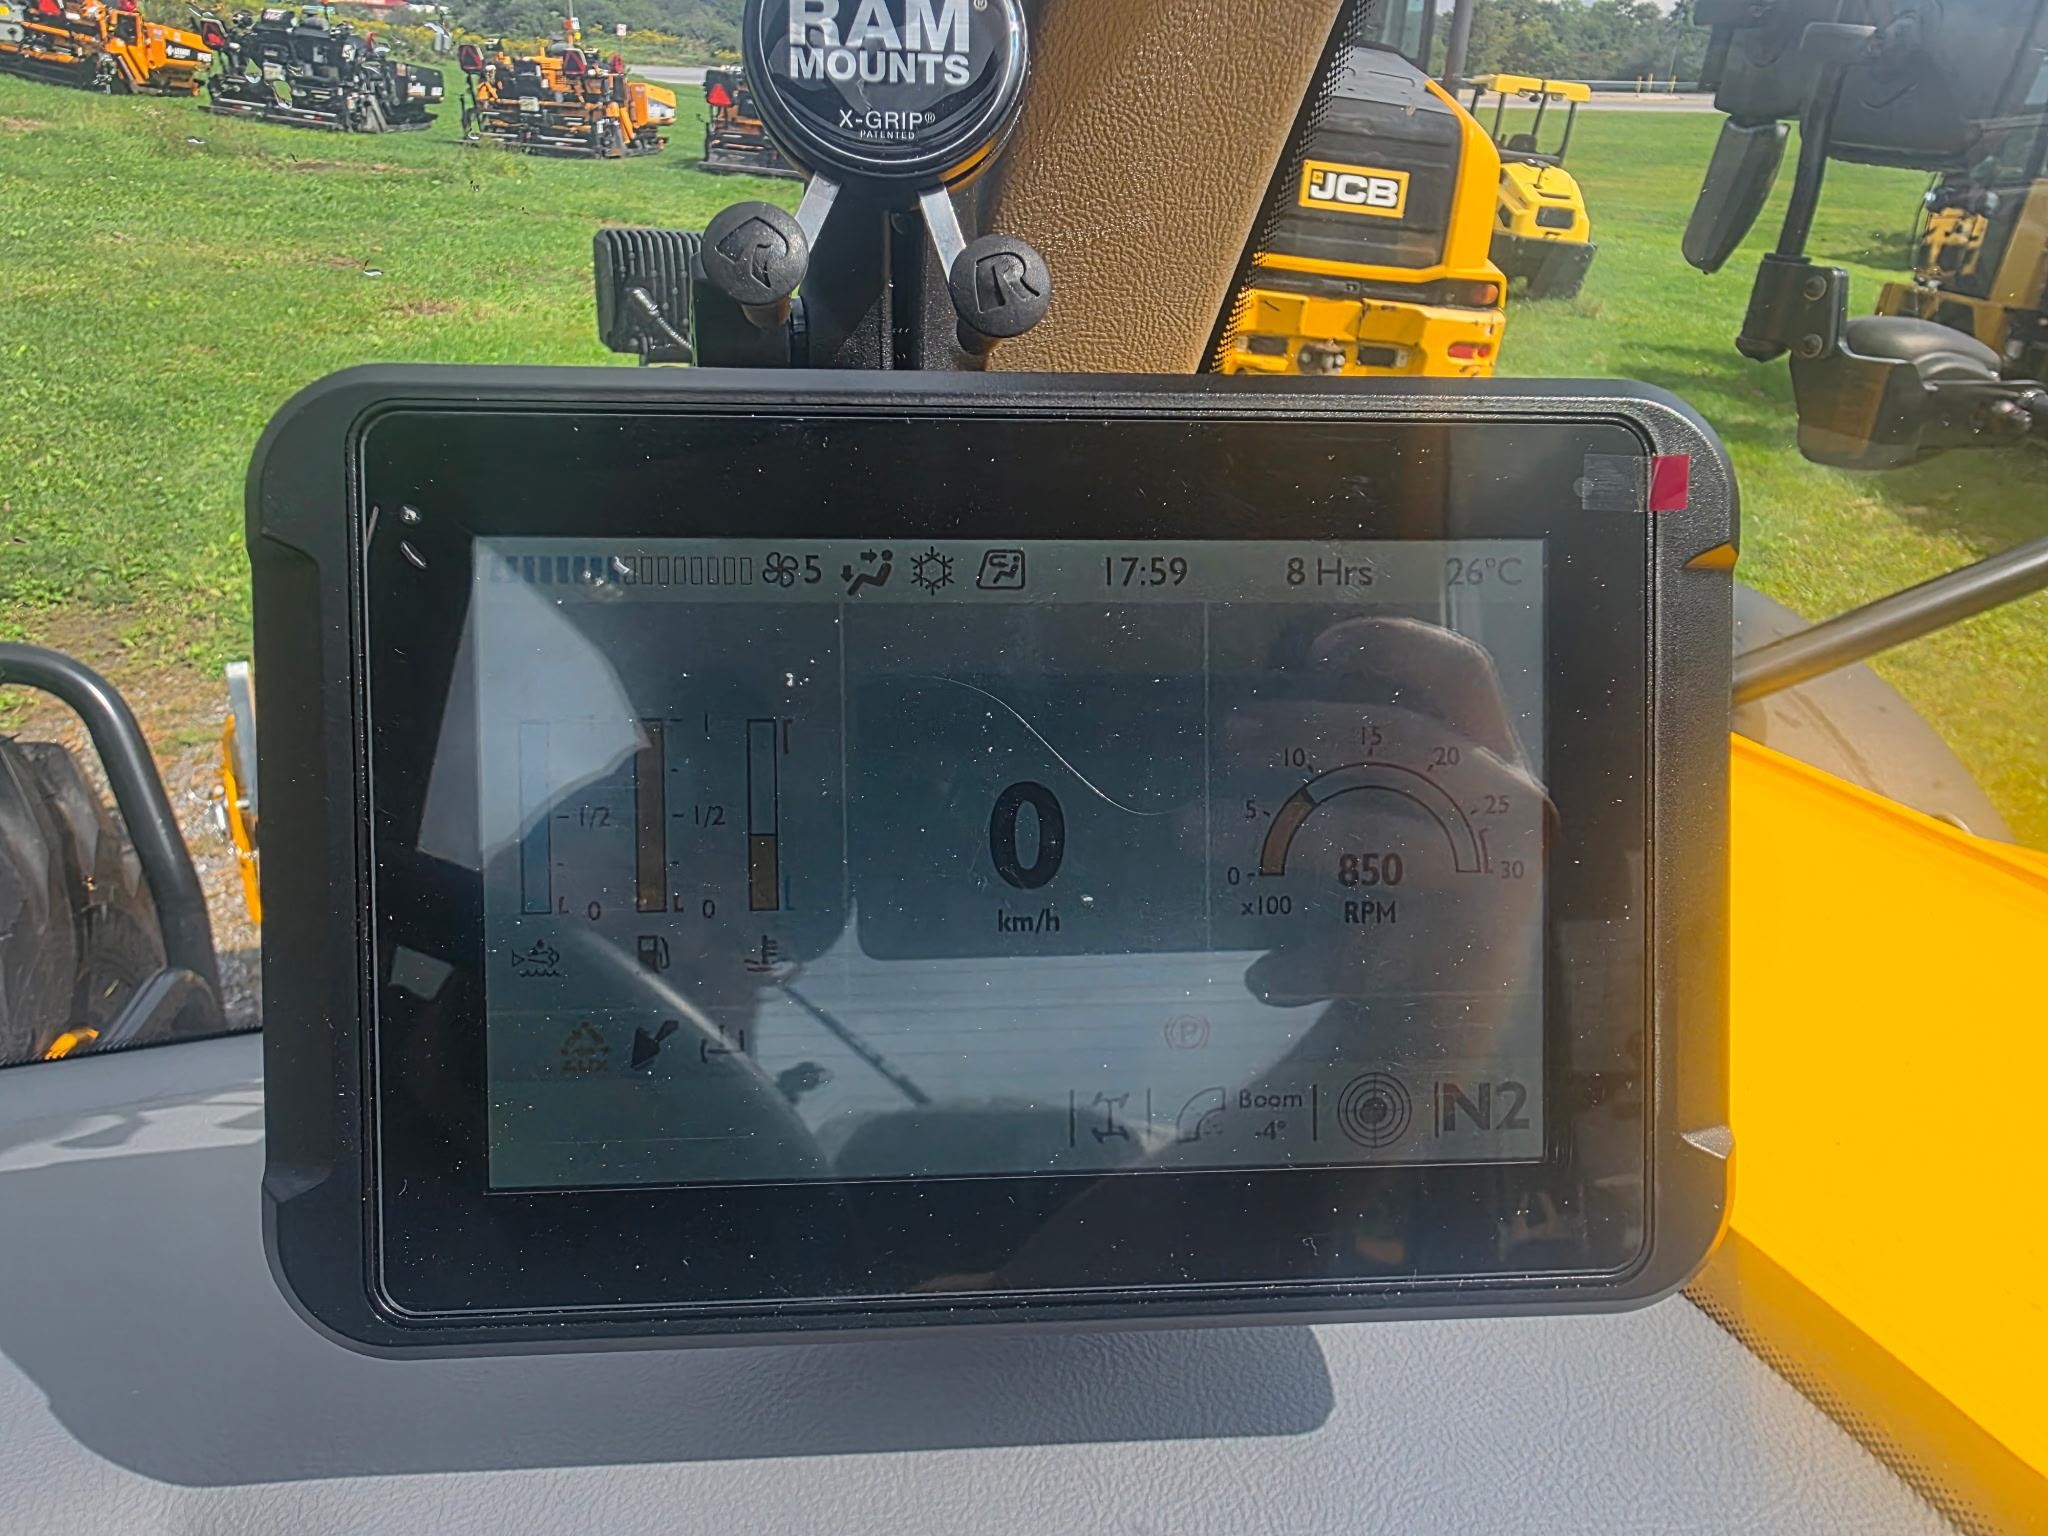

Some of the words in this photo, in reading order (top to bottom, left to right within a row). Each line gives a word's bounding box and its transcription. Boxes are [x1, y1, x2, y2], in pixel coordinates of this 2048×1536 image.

[789, 46, 970, 86] MOUNTS
[860, 130, 915, 140] PATENTED
[1310, 172, 1398, 207] JCB
[803, 555, 822, 583] 5
[1105, 556, 1188, 586] 17:59
[1286, 557, 1306, 585] 8
[1317, 557, 1374, 586] Hrs
[1445, 557, 1523, 586] 26°C
[1361, 726, 1382, 746] 15
[1284, 748, 1305, 767] 10
[1436, 747, 1460, 766] 20
[1246, 800, 1257, 820] 5
[1485, 795, 1509, 814] 25
[580, 806, 611, 828] 1/2
[695, 805, 726, 828] 1/2
[990, 781, 1065, 889] 0
[1227, 867, 1240, 886] 0
[1338, 853, 1402, 886] 850
[1501, 861, 1524, 879] 30
[587, 901, 602, 920] 0
[702, 900, 716, 918] 0
[1241, 896, 1292, 915] x100
[1345, 901, 1396, 923] RPM
[998, 908, 1060, 934] km/h
[1239, 1088, 1302, 1108] Boom
[1443, 1081, 1530, 1132] N2
